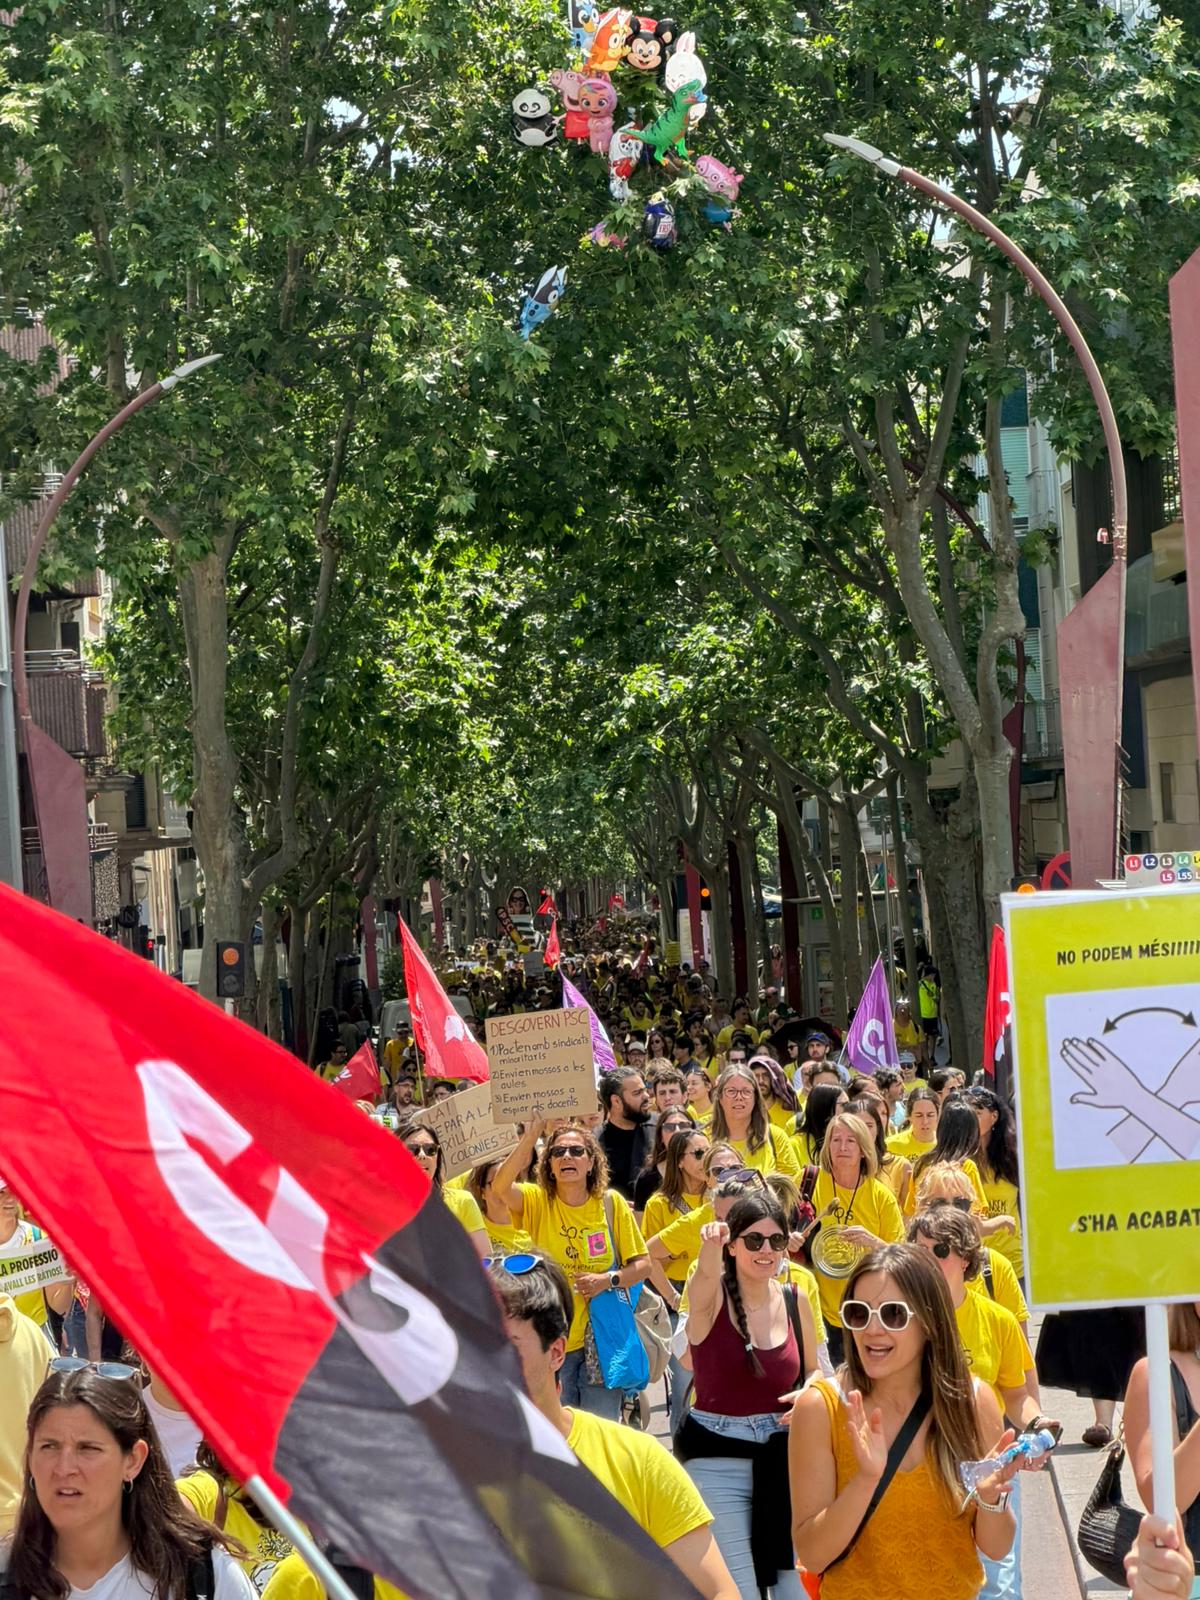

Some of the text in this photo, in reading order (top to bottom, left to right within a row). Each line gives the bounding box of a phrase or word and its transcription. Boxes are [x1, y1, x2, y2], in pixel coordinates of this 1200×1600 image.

[1145, 858, 1156, 866] L2
[1162, 857, 1173, 866] L3
[1178, 855, 1189, 864] L4
[1162, 873, 1173, 881] L5
[1177, 872, 1193, 880] L55
[1057, 950, 1076, 966] NO
[1082, 945, 1133, 963] PODEM
[490, 1009, 588, 1038] DESGOVERN PSC
[499, 1052, 546, 1065] minoritaris
[532, 1065, 561, 1076] mossos
[500, 1079, 527, 1090] aules
[533, 1087, 564, 1098] mossos
[450, 1135, 498, 1166] COLONIES
[1078, 1208, 1200, 1233] S'HA ACABAT
[24, 1274, 37, 1286] LES
